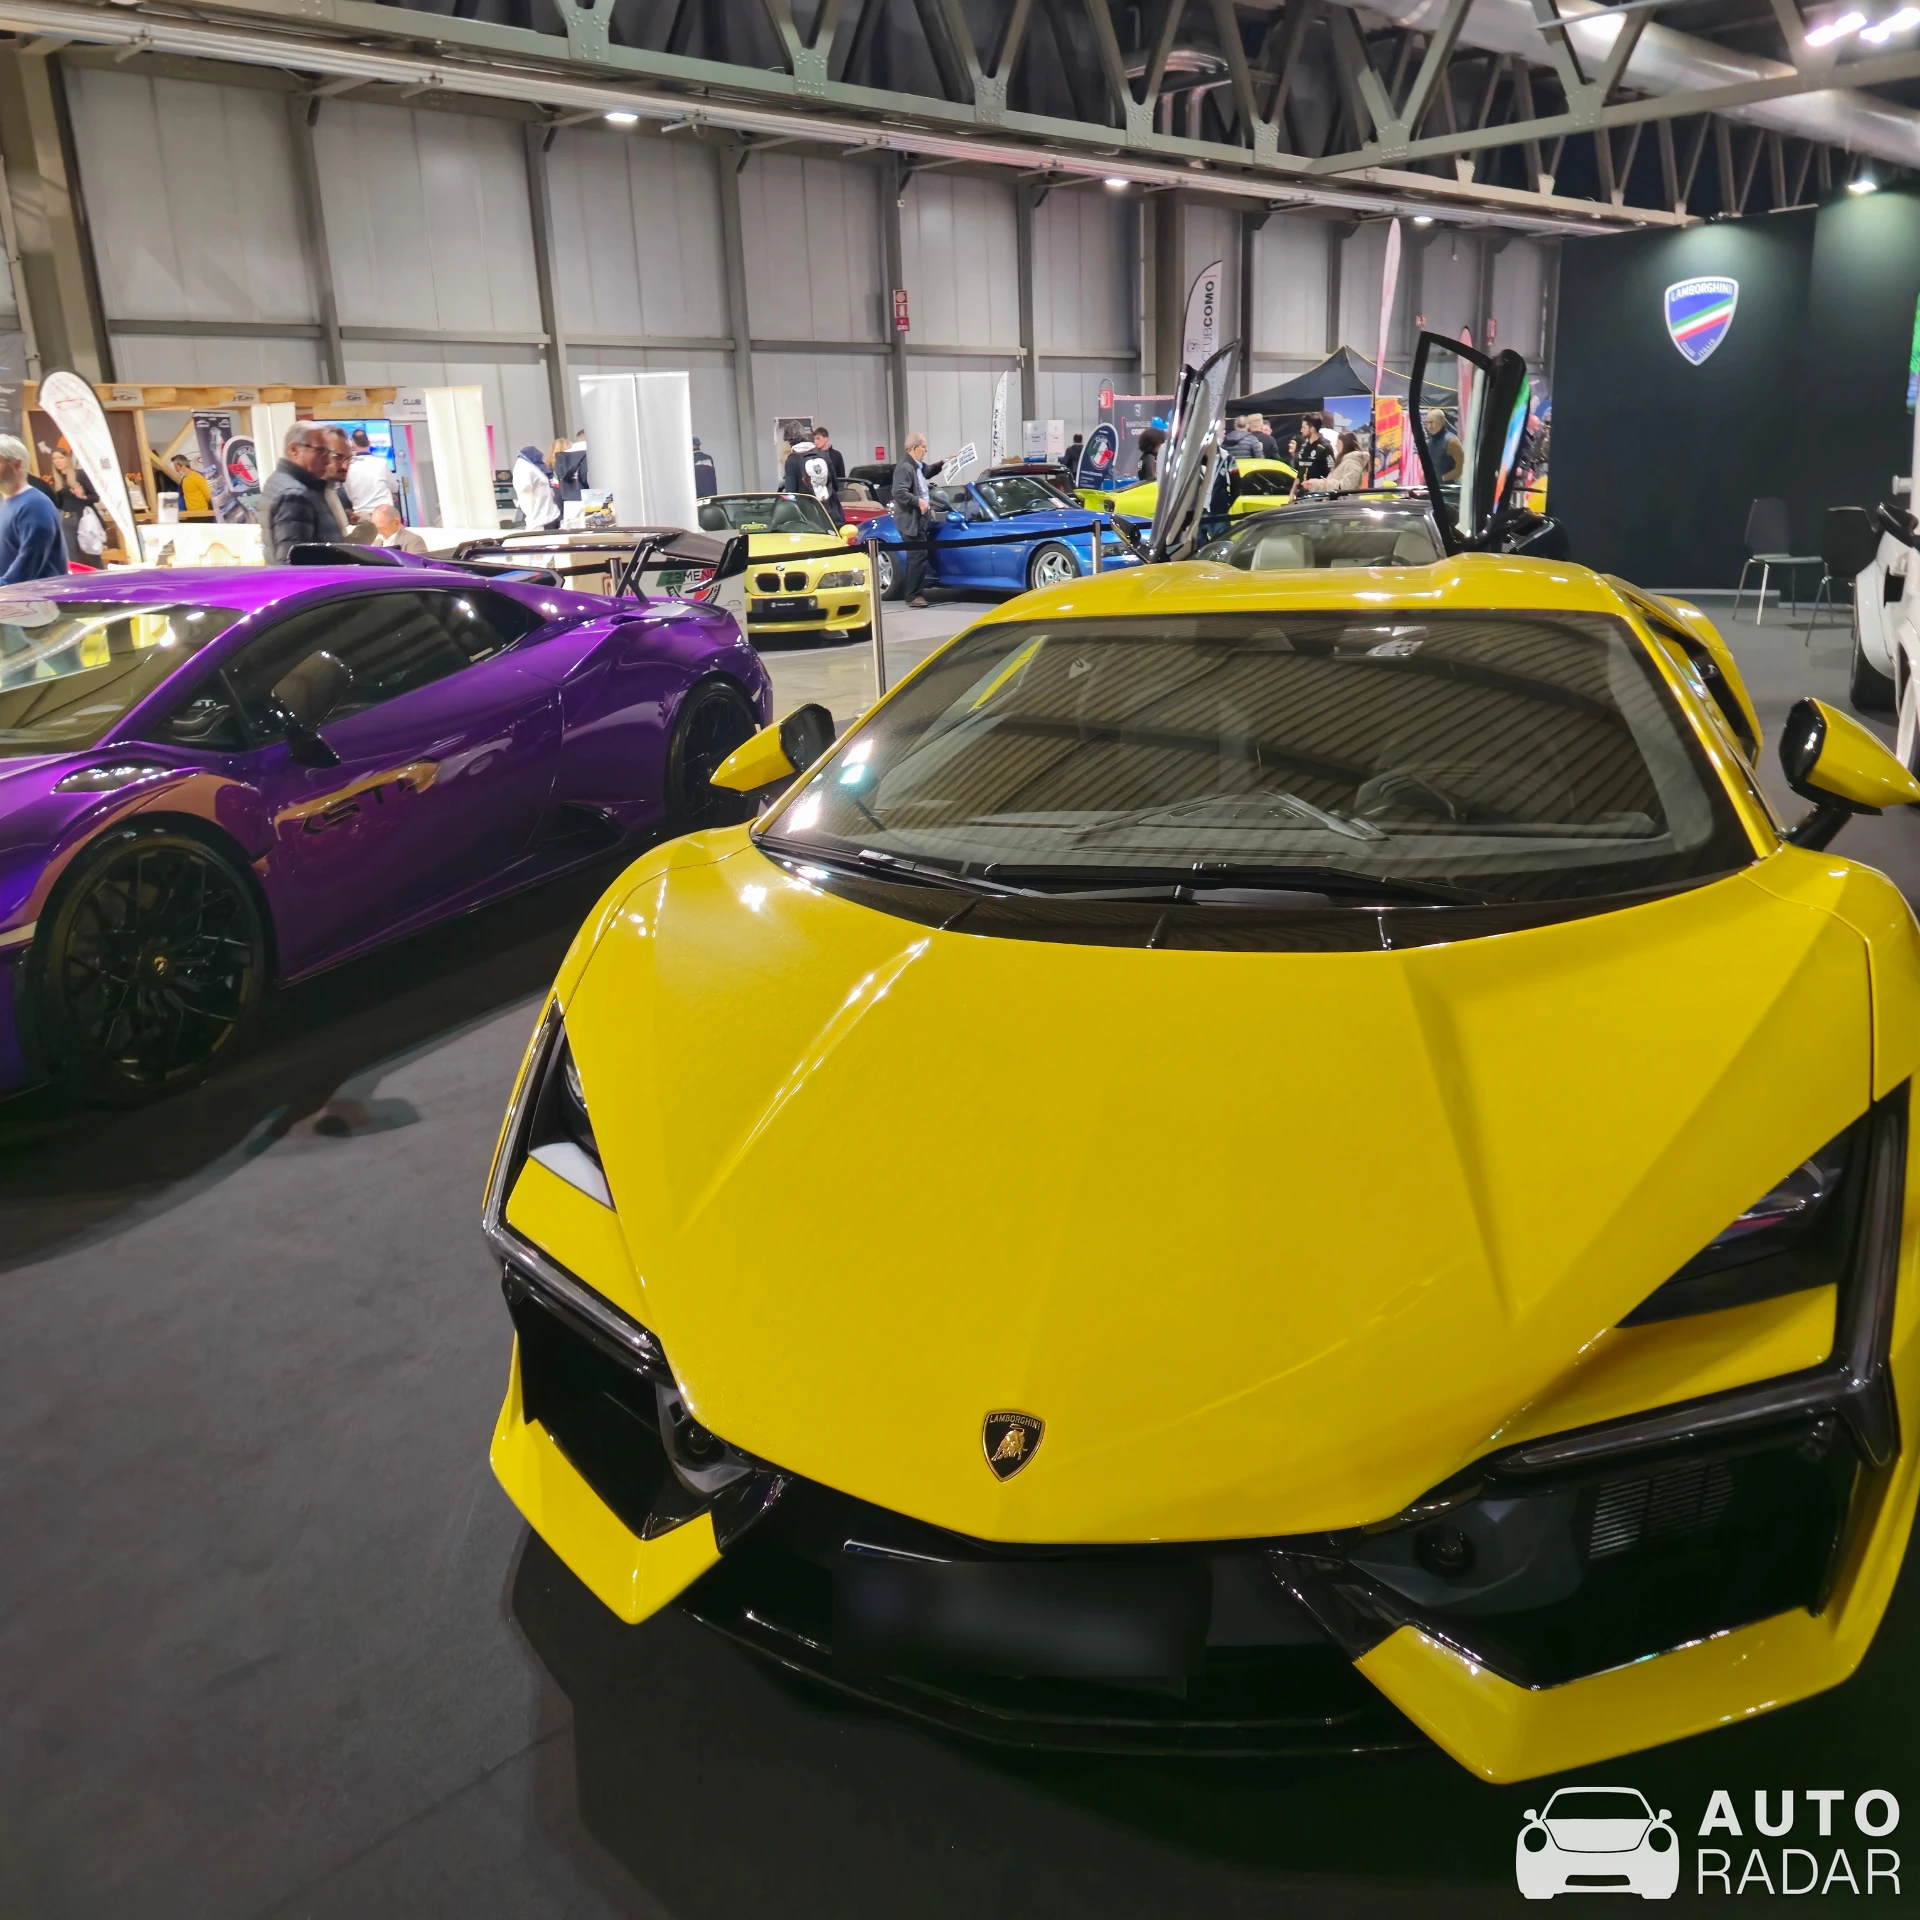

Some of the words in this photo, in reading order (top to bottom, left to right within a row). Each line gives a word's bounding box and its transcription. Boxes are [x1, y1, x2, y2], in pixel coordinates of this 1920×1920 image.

[1670, 282, 1733, 302] LAMBORGHINI
[665, 568, 717, 584] Z3MEN
[989, 1414, 1041, 1431] LAMBORGHINI
